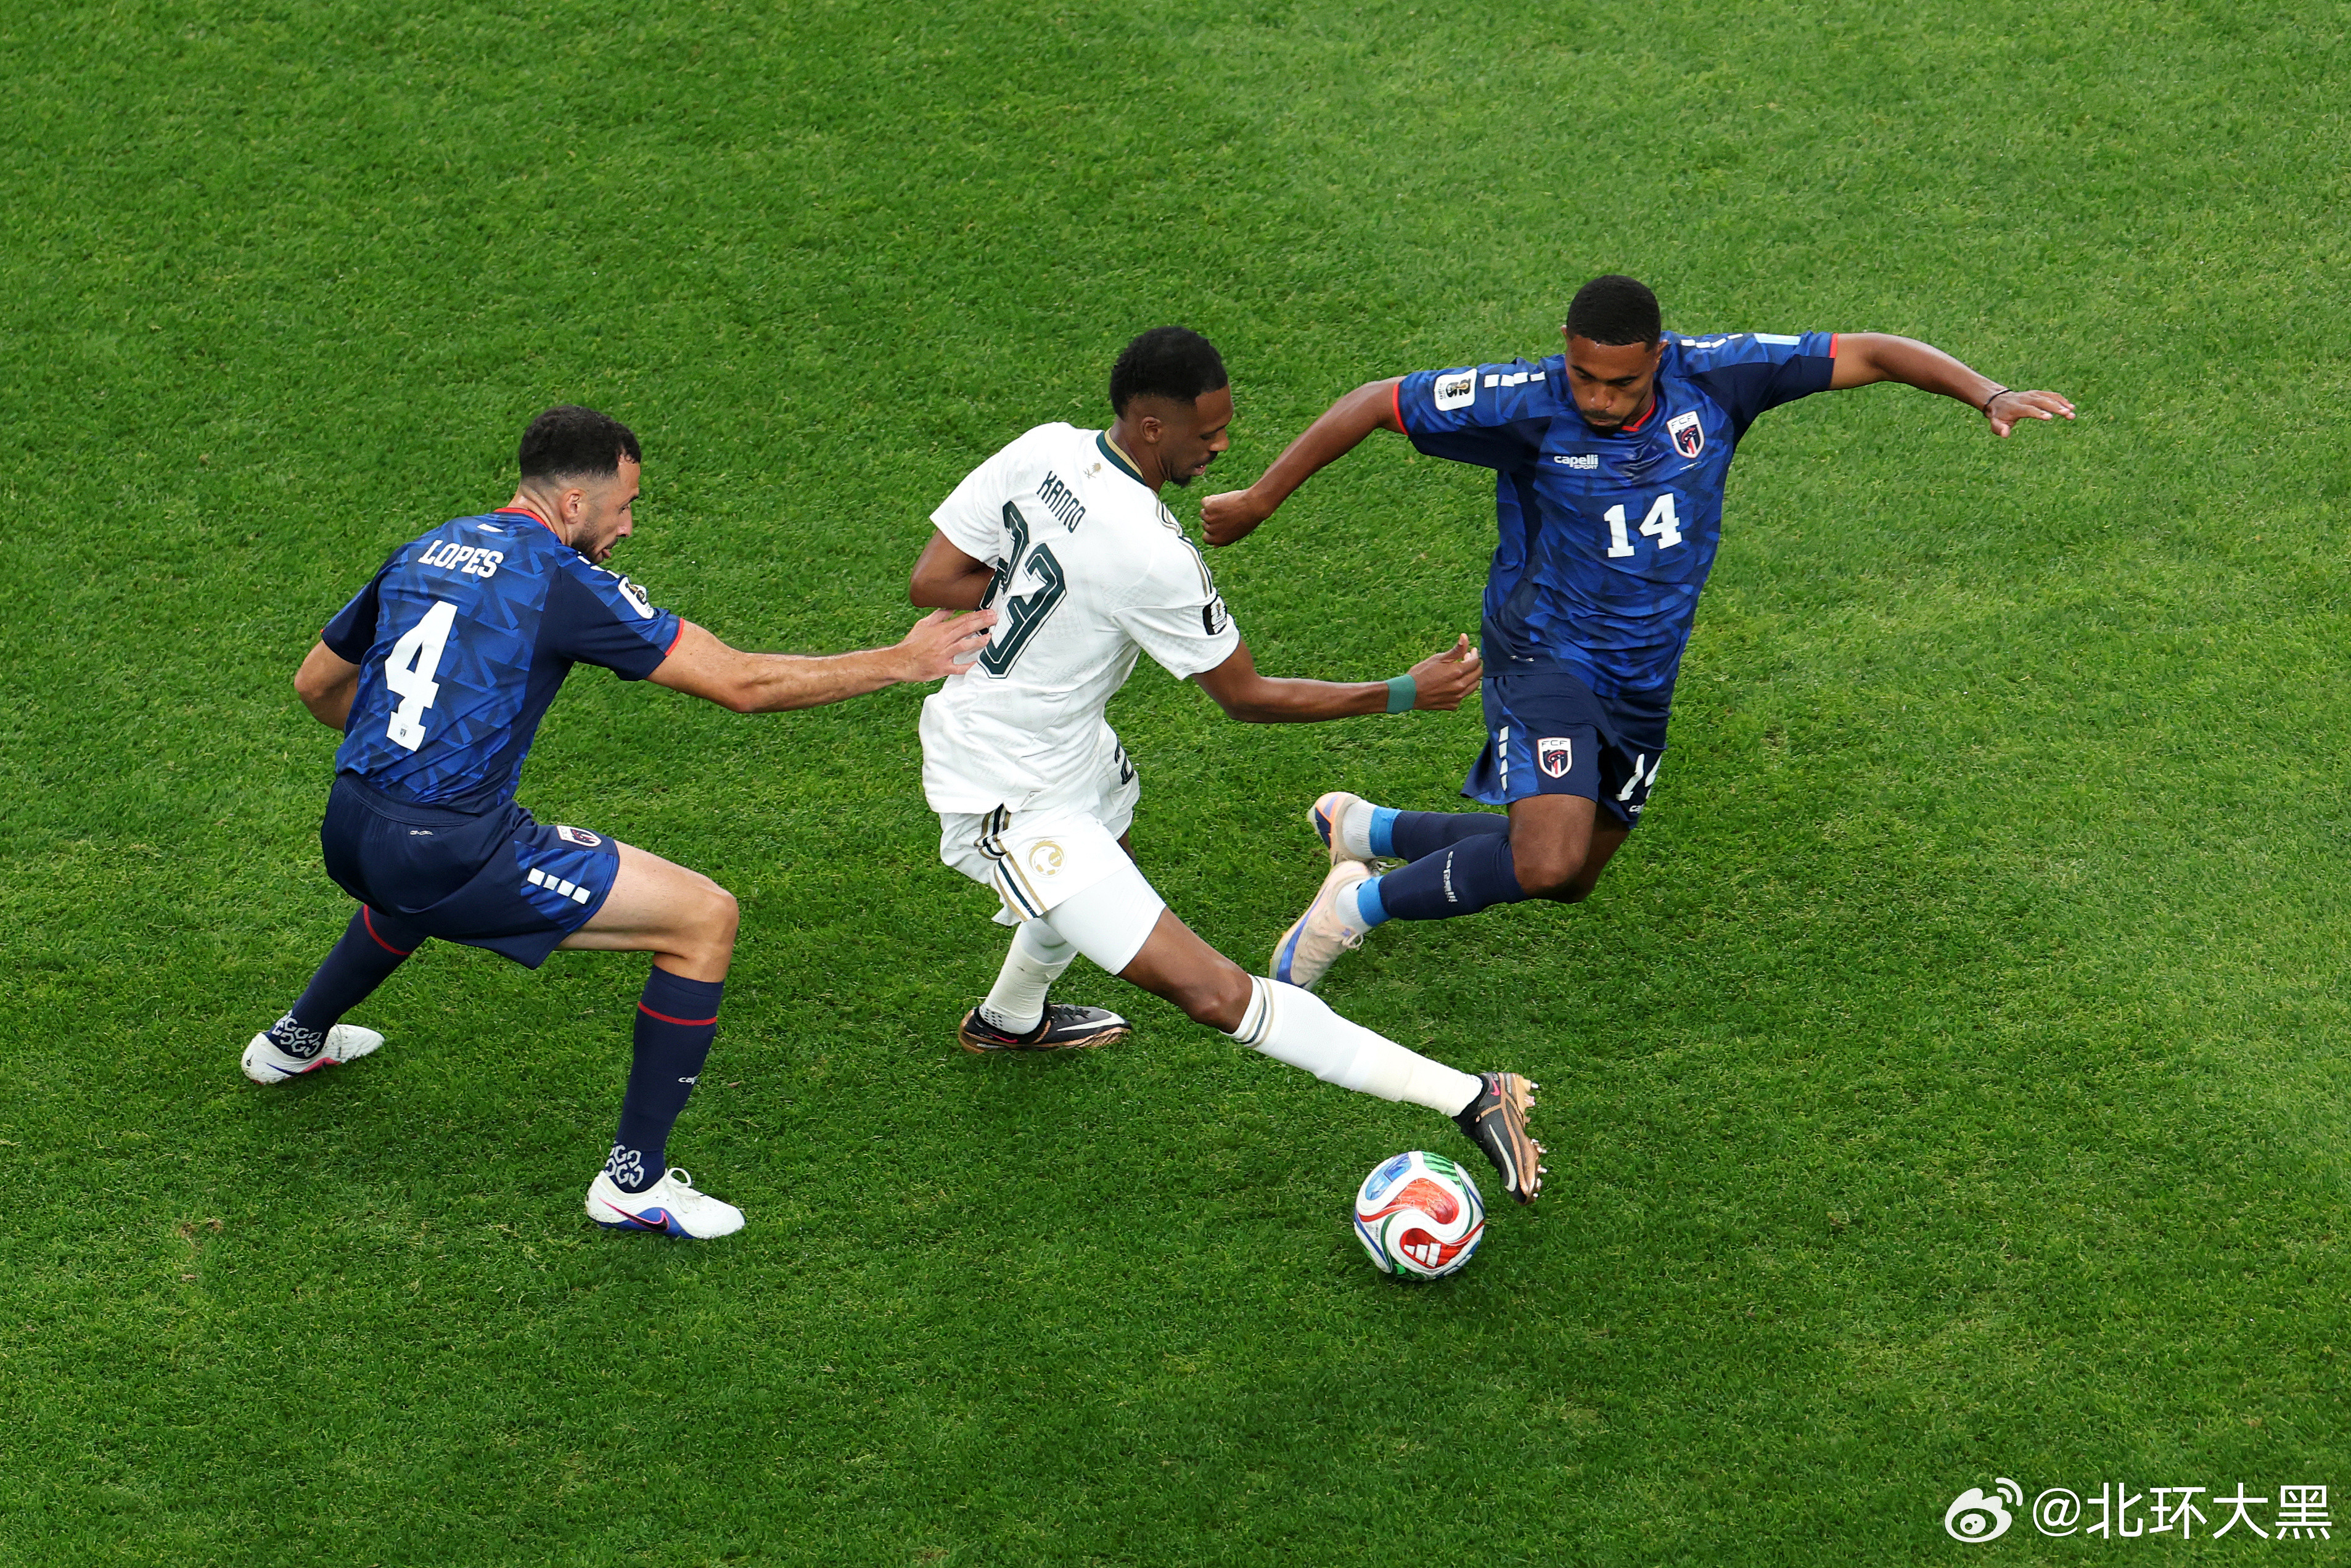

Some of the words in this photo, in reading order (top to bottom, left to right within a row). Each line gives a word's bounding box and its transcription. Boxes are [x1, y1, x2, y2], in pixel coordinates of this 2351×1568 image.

[1671, 414, 1694, 429] FCF
[1554, 454, 1599, 467] capelli
[1036, 470, 1086, 533] KANNO
[1604, 493, 1682, 558] 14
[417, 540, 504, 578] LOPES
[385, 600, 458, 752] 4
